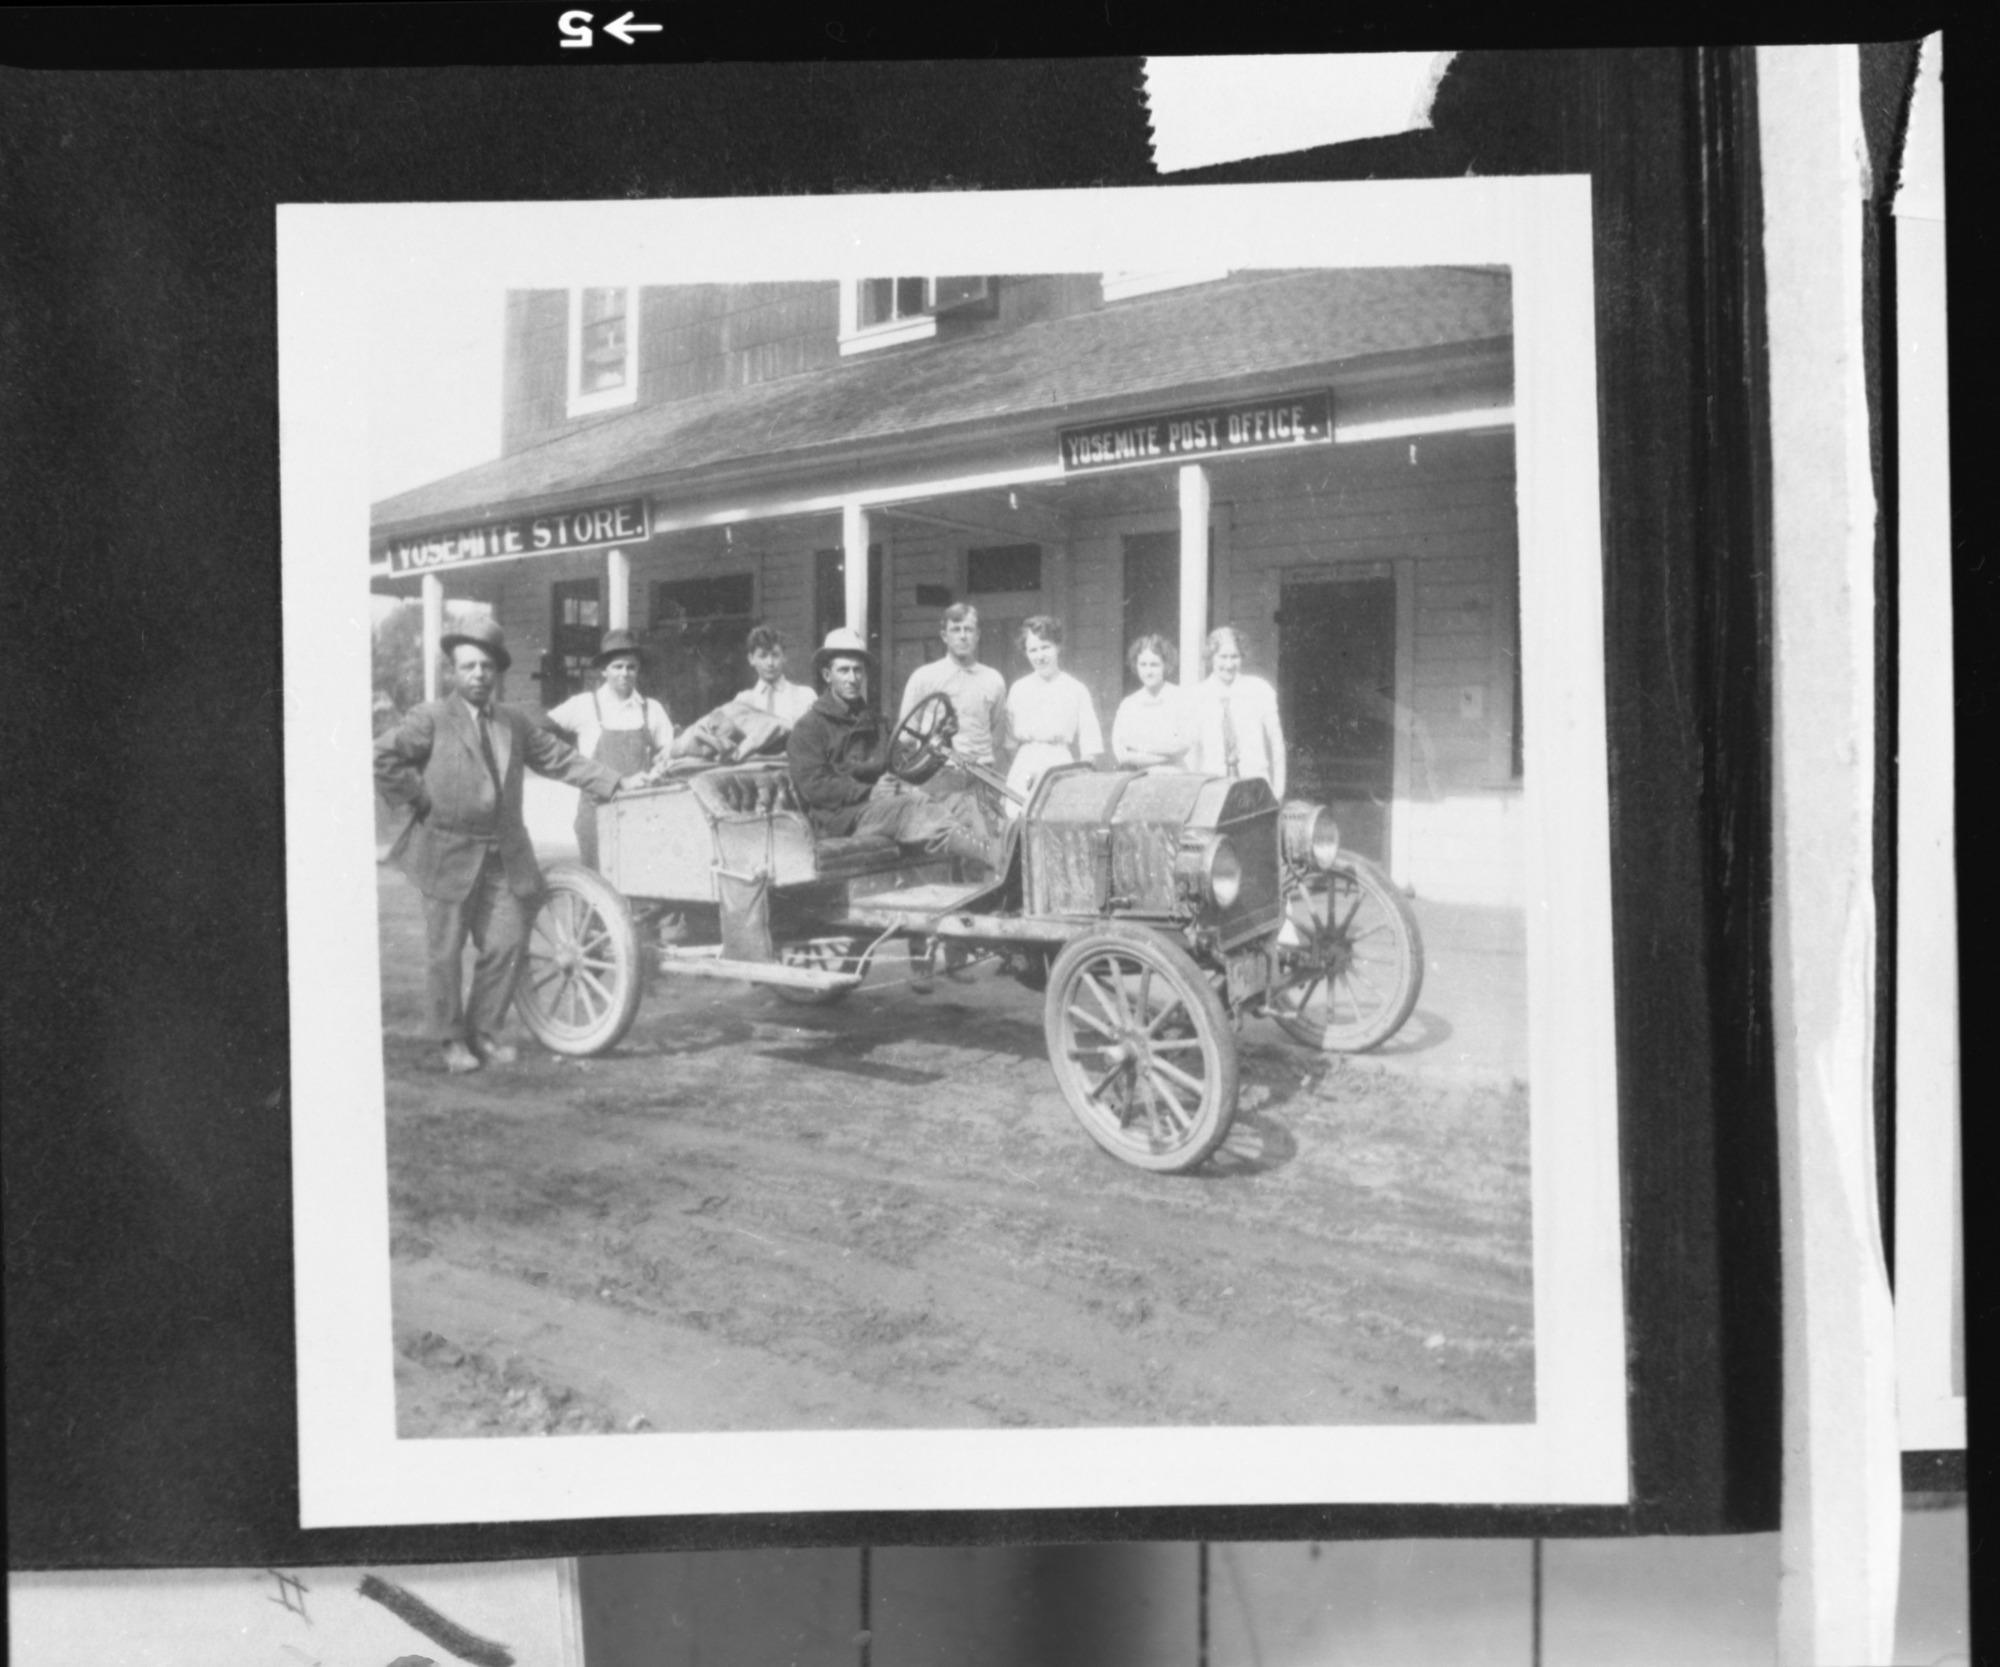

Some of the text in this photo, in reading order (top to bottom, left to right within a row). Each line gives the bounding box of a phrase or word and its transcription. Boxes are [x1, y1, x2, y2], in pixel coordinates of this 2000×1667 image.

[557, 9, 594, 48] 5
[1067, 405, 1319, 466] YOSEMITE POST OFFICE.
[399, 503, 644, 570] YOSEMITE STORE.
